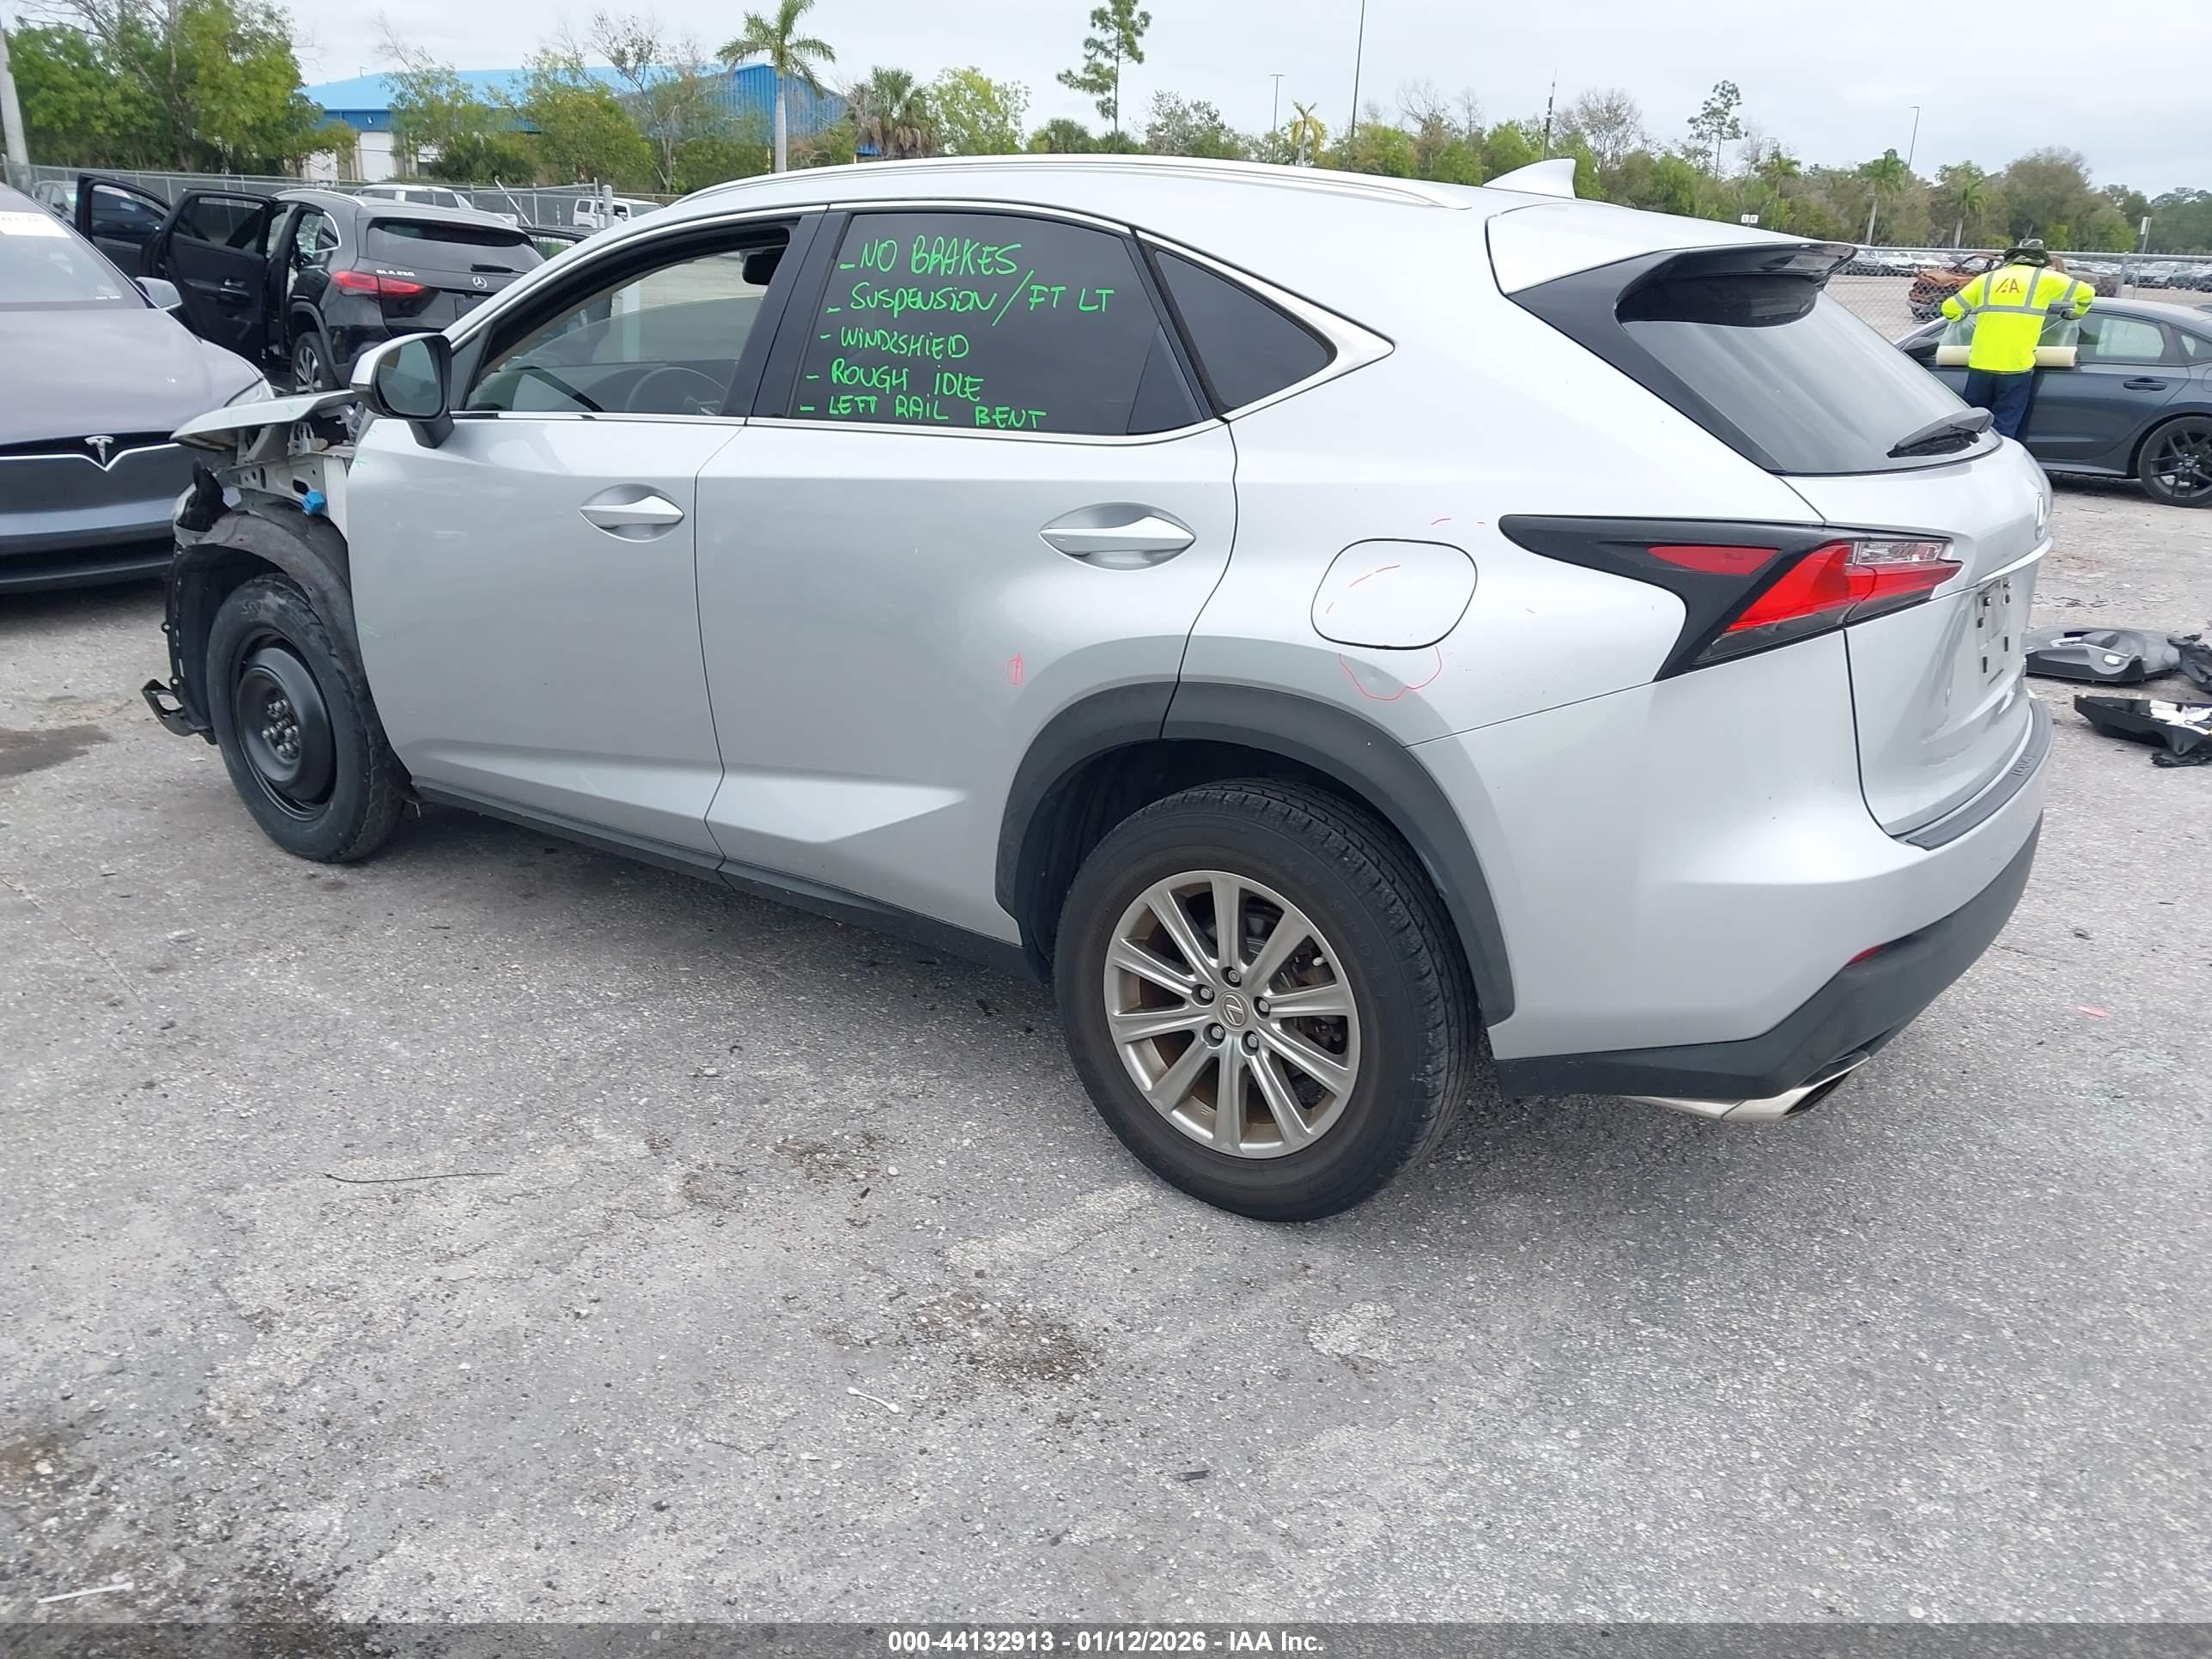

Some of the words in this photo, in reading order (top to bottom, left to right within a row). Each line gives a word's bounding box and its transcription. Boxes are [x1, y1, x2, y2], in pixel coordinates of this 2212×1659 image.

[860, 238, 898, 273] NO
[910, 234, 1022, 276] BRAKES
[1078, 288, 1115, 313] LT
[830, 357, 909, 395] ROUGH
[933, 364, 985, 403] IDLE
[828, 394, 879, 415] LEFT
[895, 392, 950, 421] RAIL
[974, 405, 1048, 429] BENT
